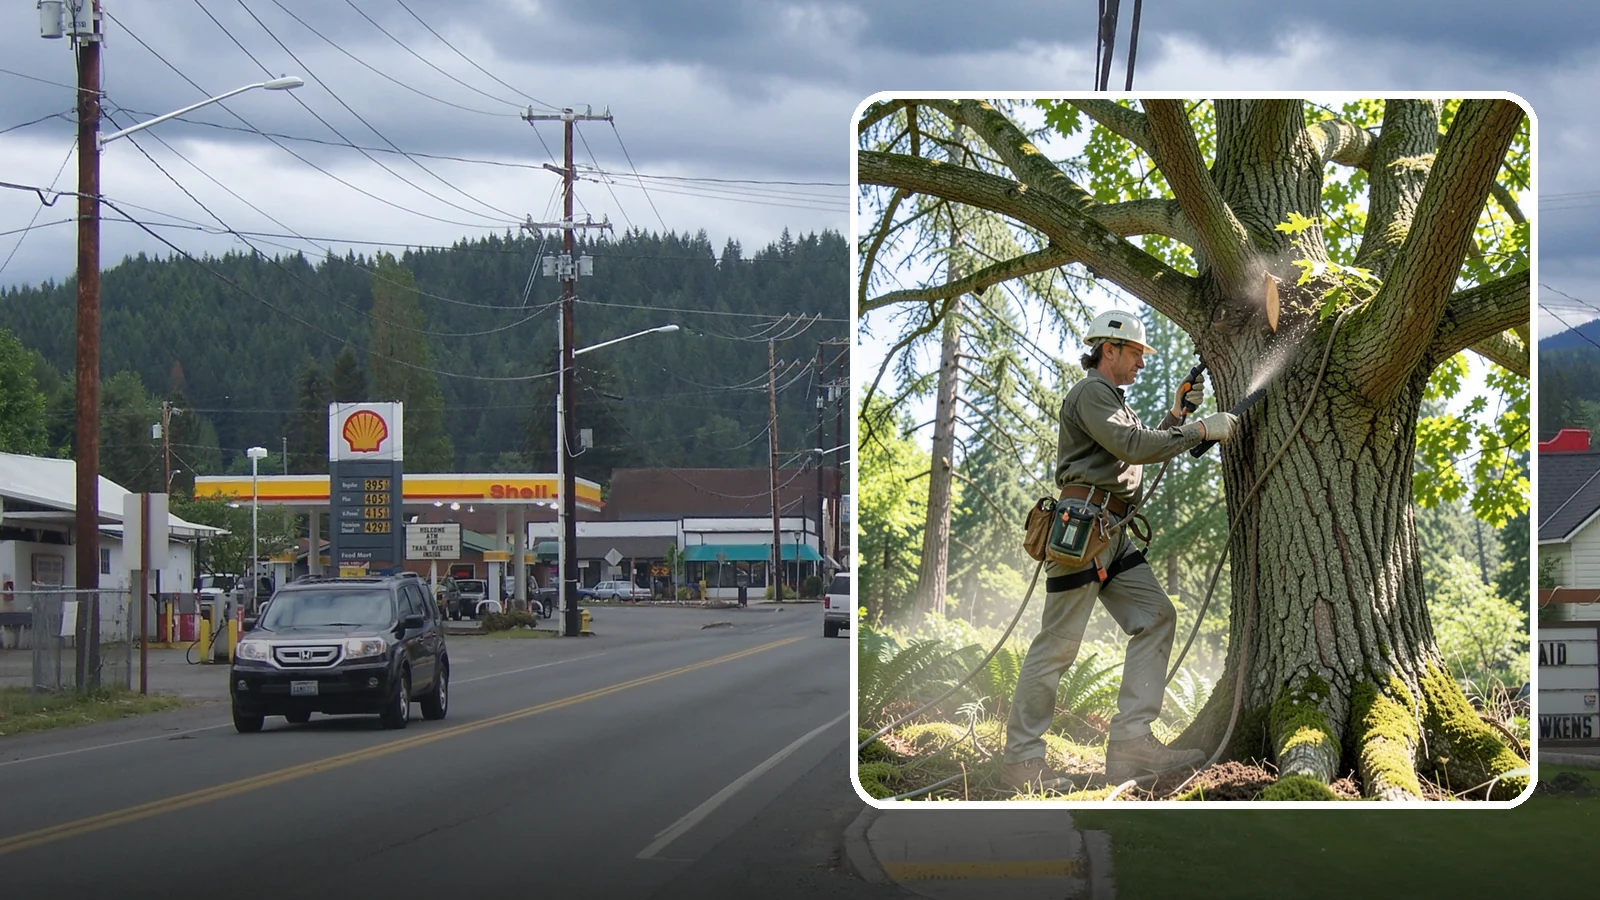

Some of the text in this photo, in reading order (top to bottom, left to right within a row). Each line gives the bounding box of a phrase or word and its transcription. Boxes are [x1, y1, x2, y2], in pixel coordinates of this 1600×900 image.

[365, 480, 384, 490] 395
[490, 484, 547, 499] Shell
[365, 494, 384, 504] 405
[365, 508, 384, 518] 415
[365, 522, 384, 532] 429
[1539, 643, 1566, 665] AID
